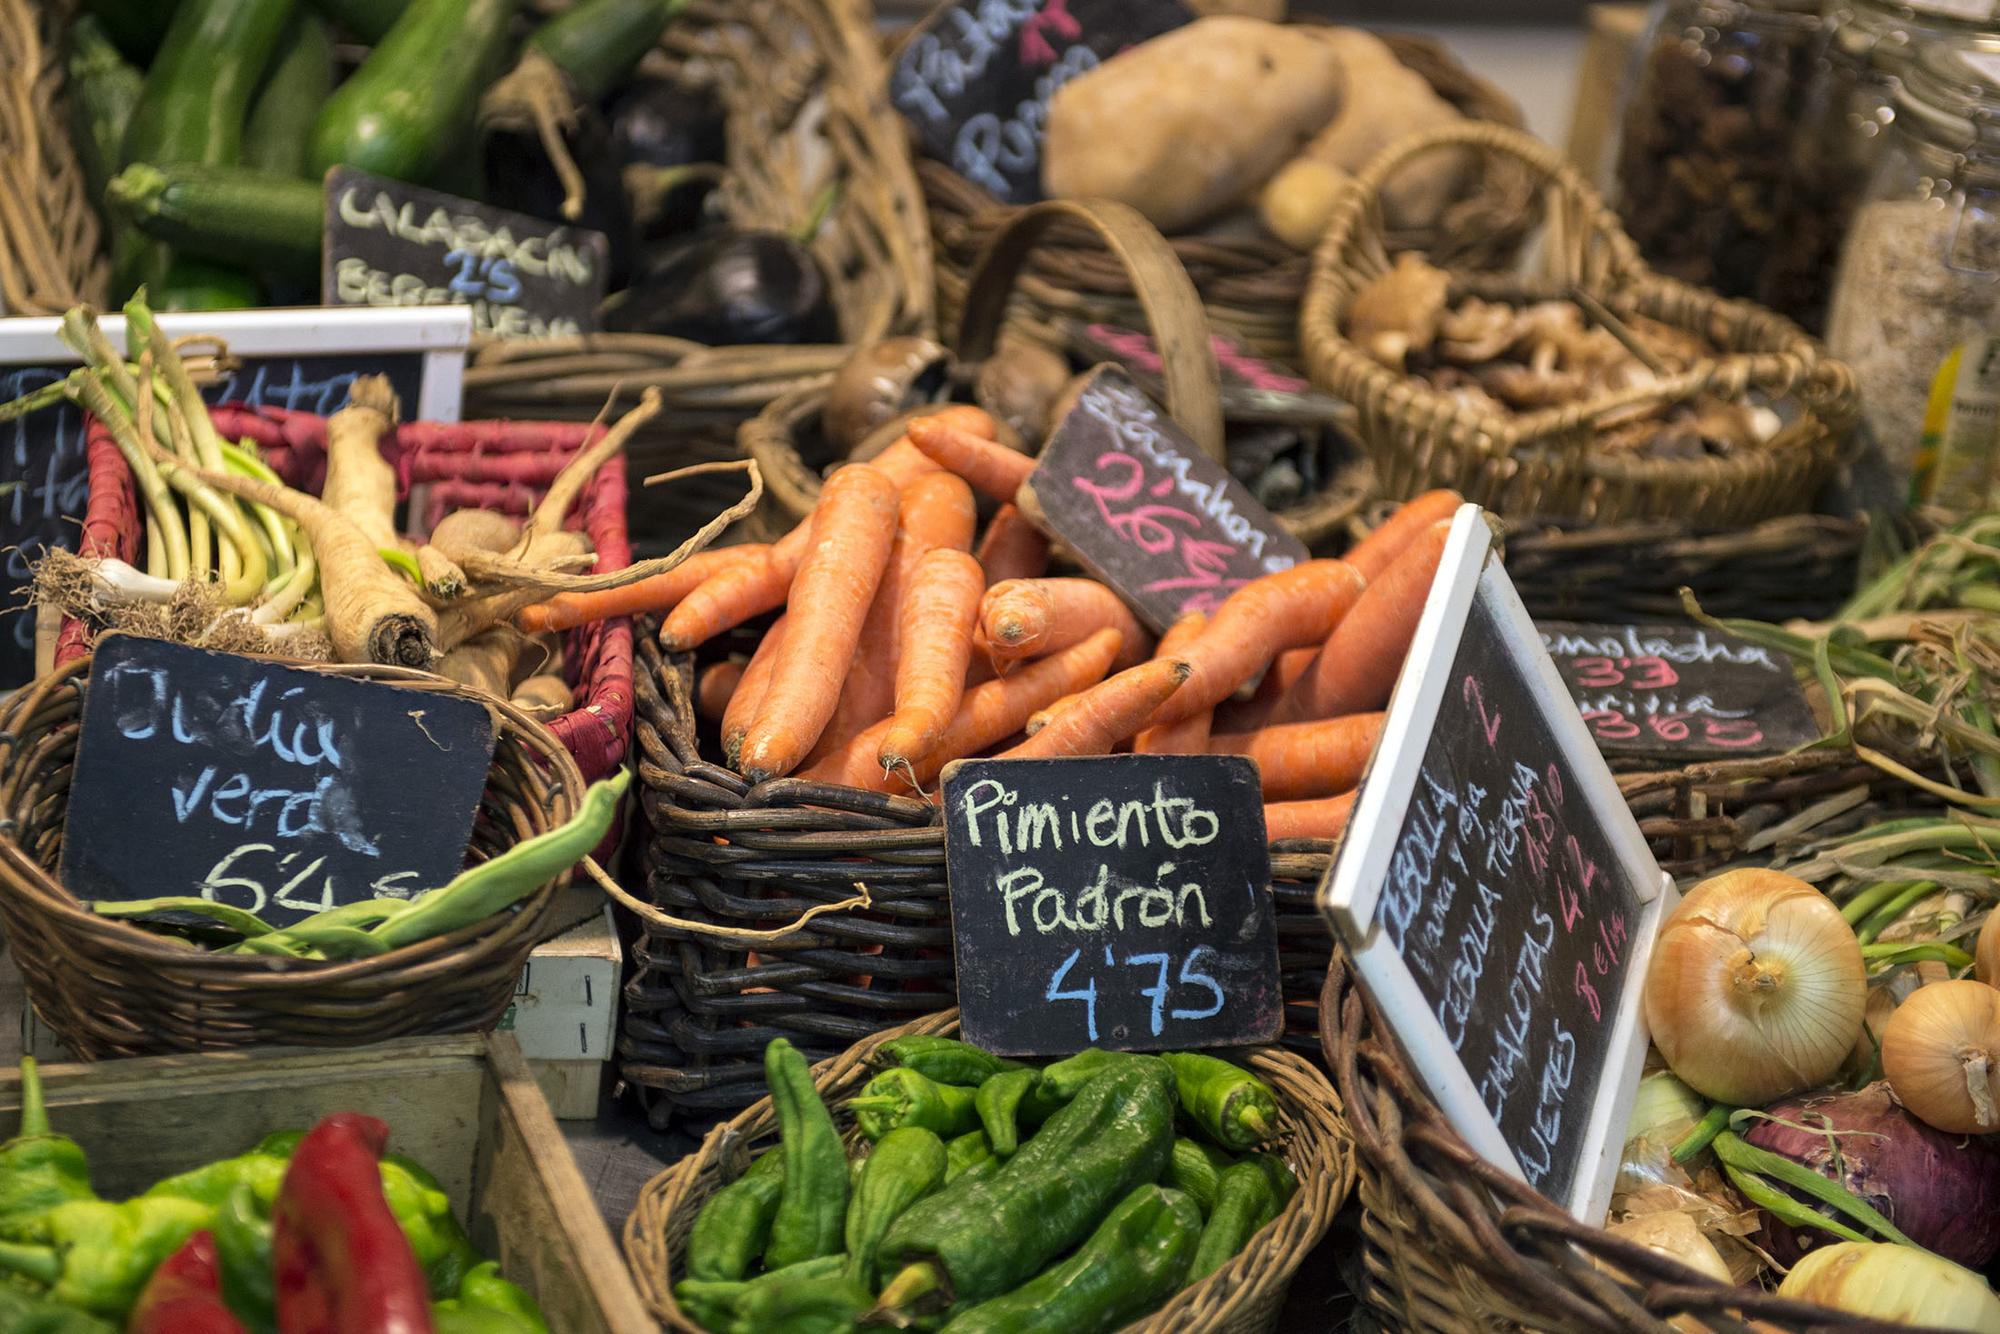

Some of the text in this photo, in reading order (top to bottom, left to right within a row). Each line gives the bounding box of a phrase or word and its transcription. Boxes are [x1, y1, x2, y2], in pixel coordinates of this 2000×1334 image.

[443, 248, 523, 304] 2'5
[1463, 675, 1502, 750] 2
[960, 780, 1220, 855] Pimiento
[996, 863, 1214, 937] Padrón
[1440, 761, 1540, 1051] CEBOLLA TIERNA
[1045, 944, 1226, 1042] 4'75
[1480, 903, 1556, 1127] CHALOTAS
